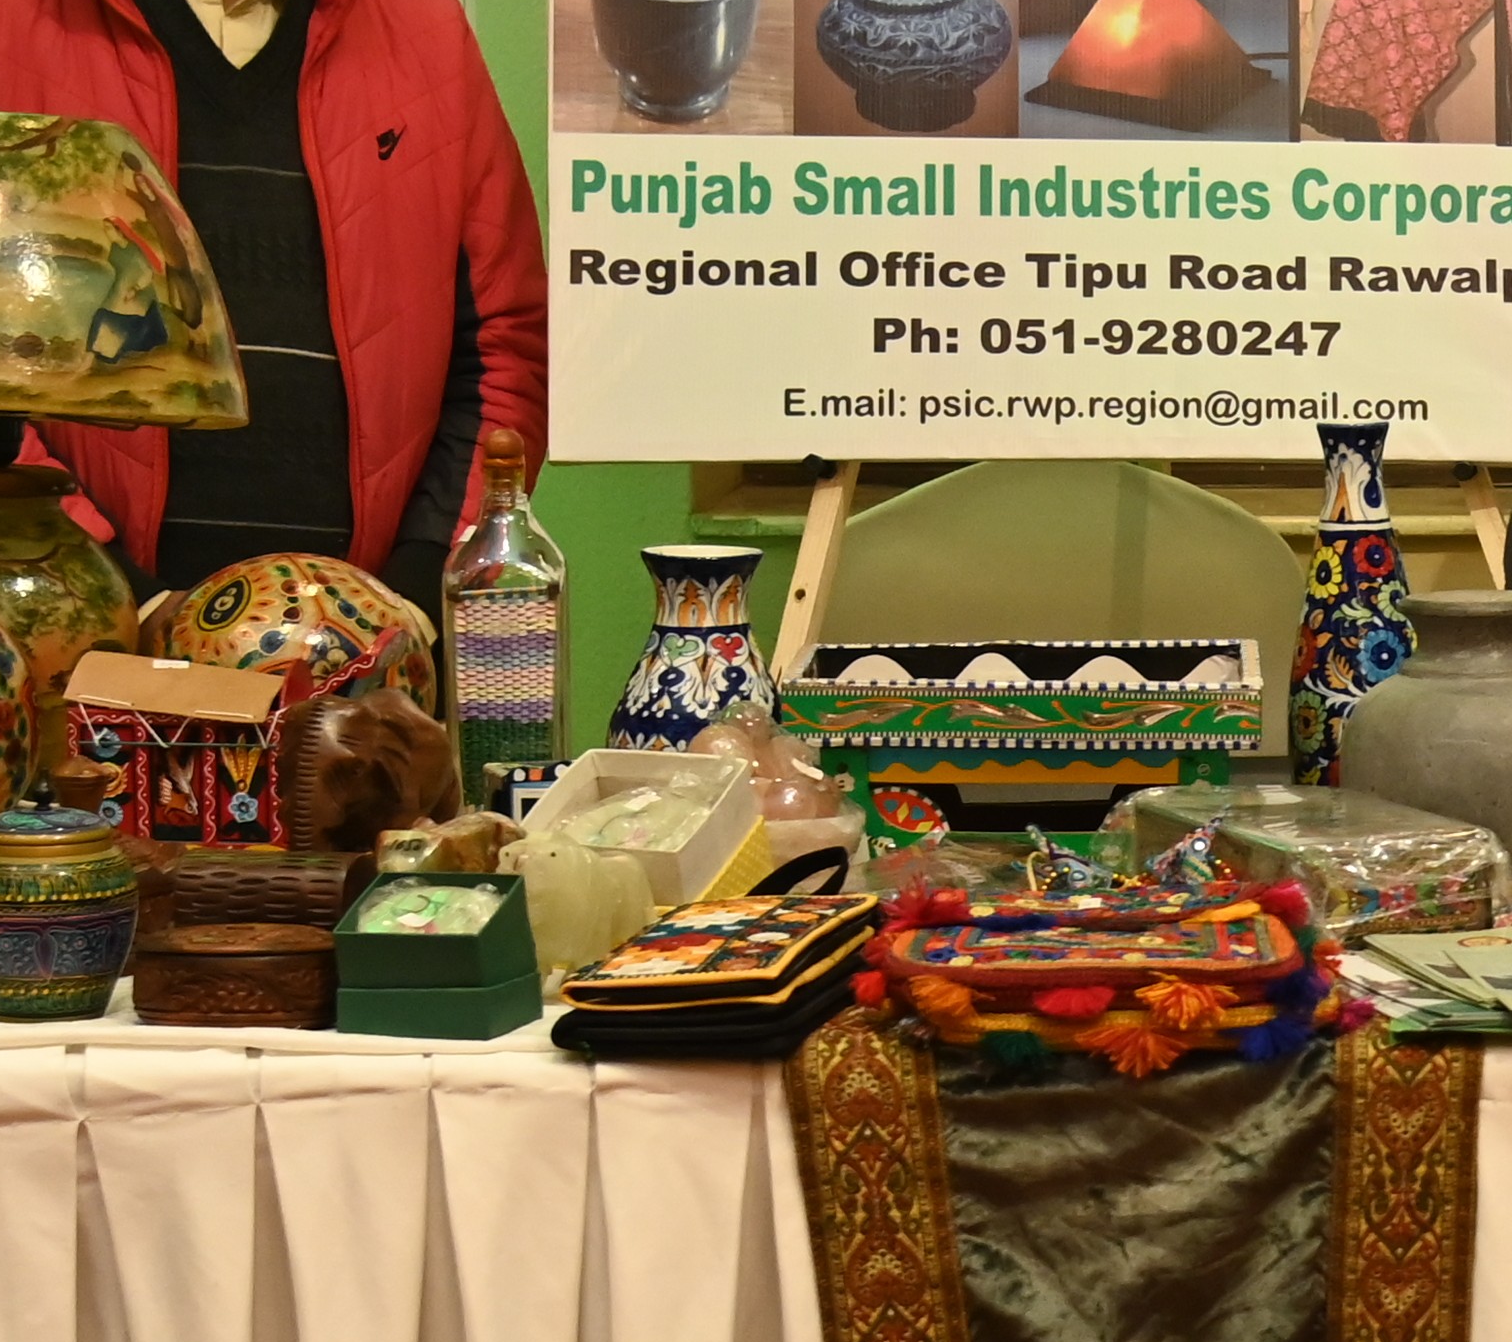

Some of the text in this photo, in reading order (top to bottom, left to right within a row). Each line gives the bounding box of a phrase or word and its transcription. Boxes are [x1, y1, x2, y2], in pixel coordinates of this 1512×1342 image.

[572, 160, 771, 228] Punjab
[793, 162, 954, 216] Small
[980, 164, 1270, 220] Industries
[570, 250, 816, 295] Regional
[840, 251, 1005, 287] Office
[1025, 253, 1150, 297] Tipu
[1170, 255, 1306, 290] Road
[874, 318, 1341, 356] Ph: 051-9280247
[784, 388, 1427, 427] E.mail: psic.rwp.region@gmail.com
